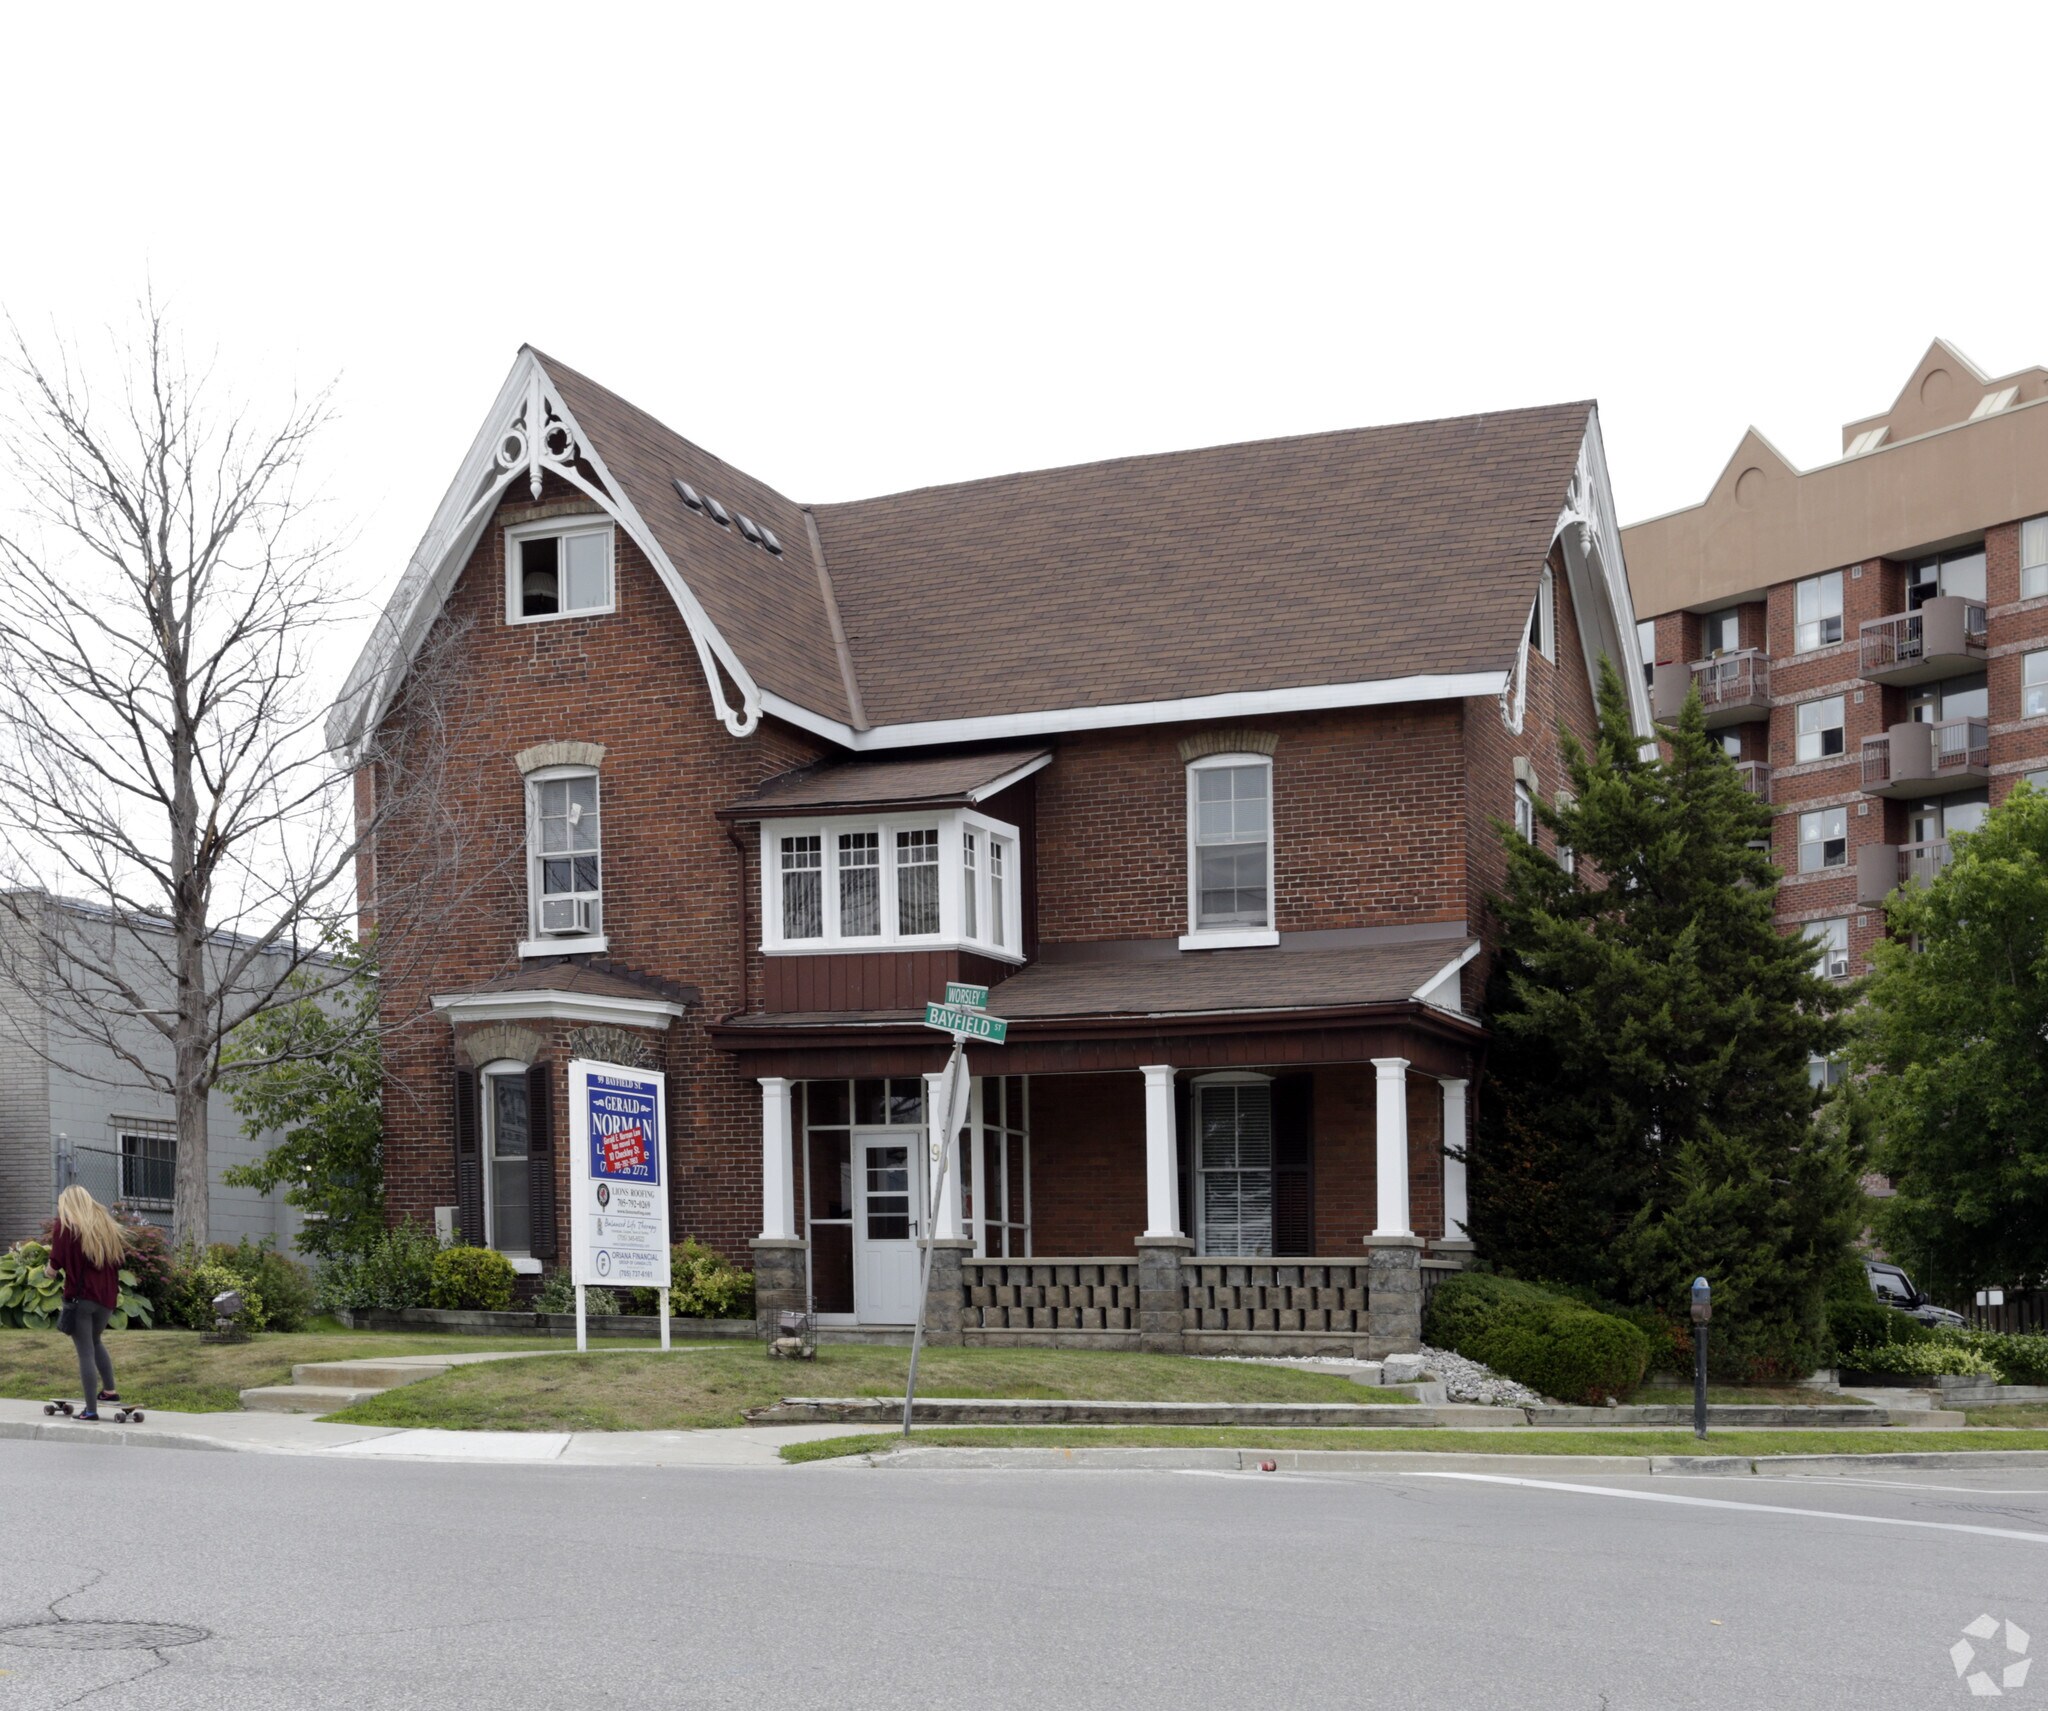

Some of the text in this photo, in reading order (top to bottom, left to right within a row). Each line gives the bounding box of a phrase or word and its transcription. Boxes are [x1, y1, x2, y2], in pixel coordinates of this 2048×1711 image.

[948, 987, 986, 1005] WORSLEY ST
[929, 1007, 990, 1036] BAYFIELD
[597, 1075, 604, 1084] 99
[605, 1076, 634, 1089] BAYFIELD
[605, 1096, 640, 1114] GERALD
[604, 1135, 615, 1145] Gerald
[619, 1131, 633, 1140] Norman
[632, 1164, 648, 1176] 2772
[612, 1187, 655, 1199] LIONS ROOFING
[605, 1217, 626, 1228] Balanced
[637, 1220, 656, 1234] Therapy
[612, 1251, 659, 1261] ORIANA FINANCIAL
